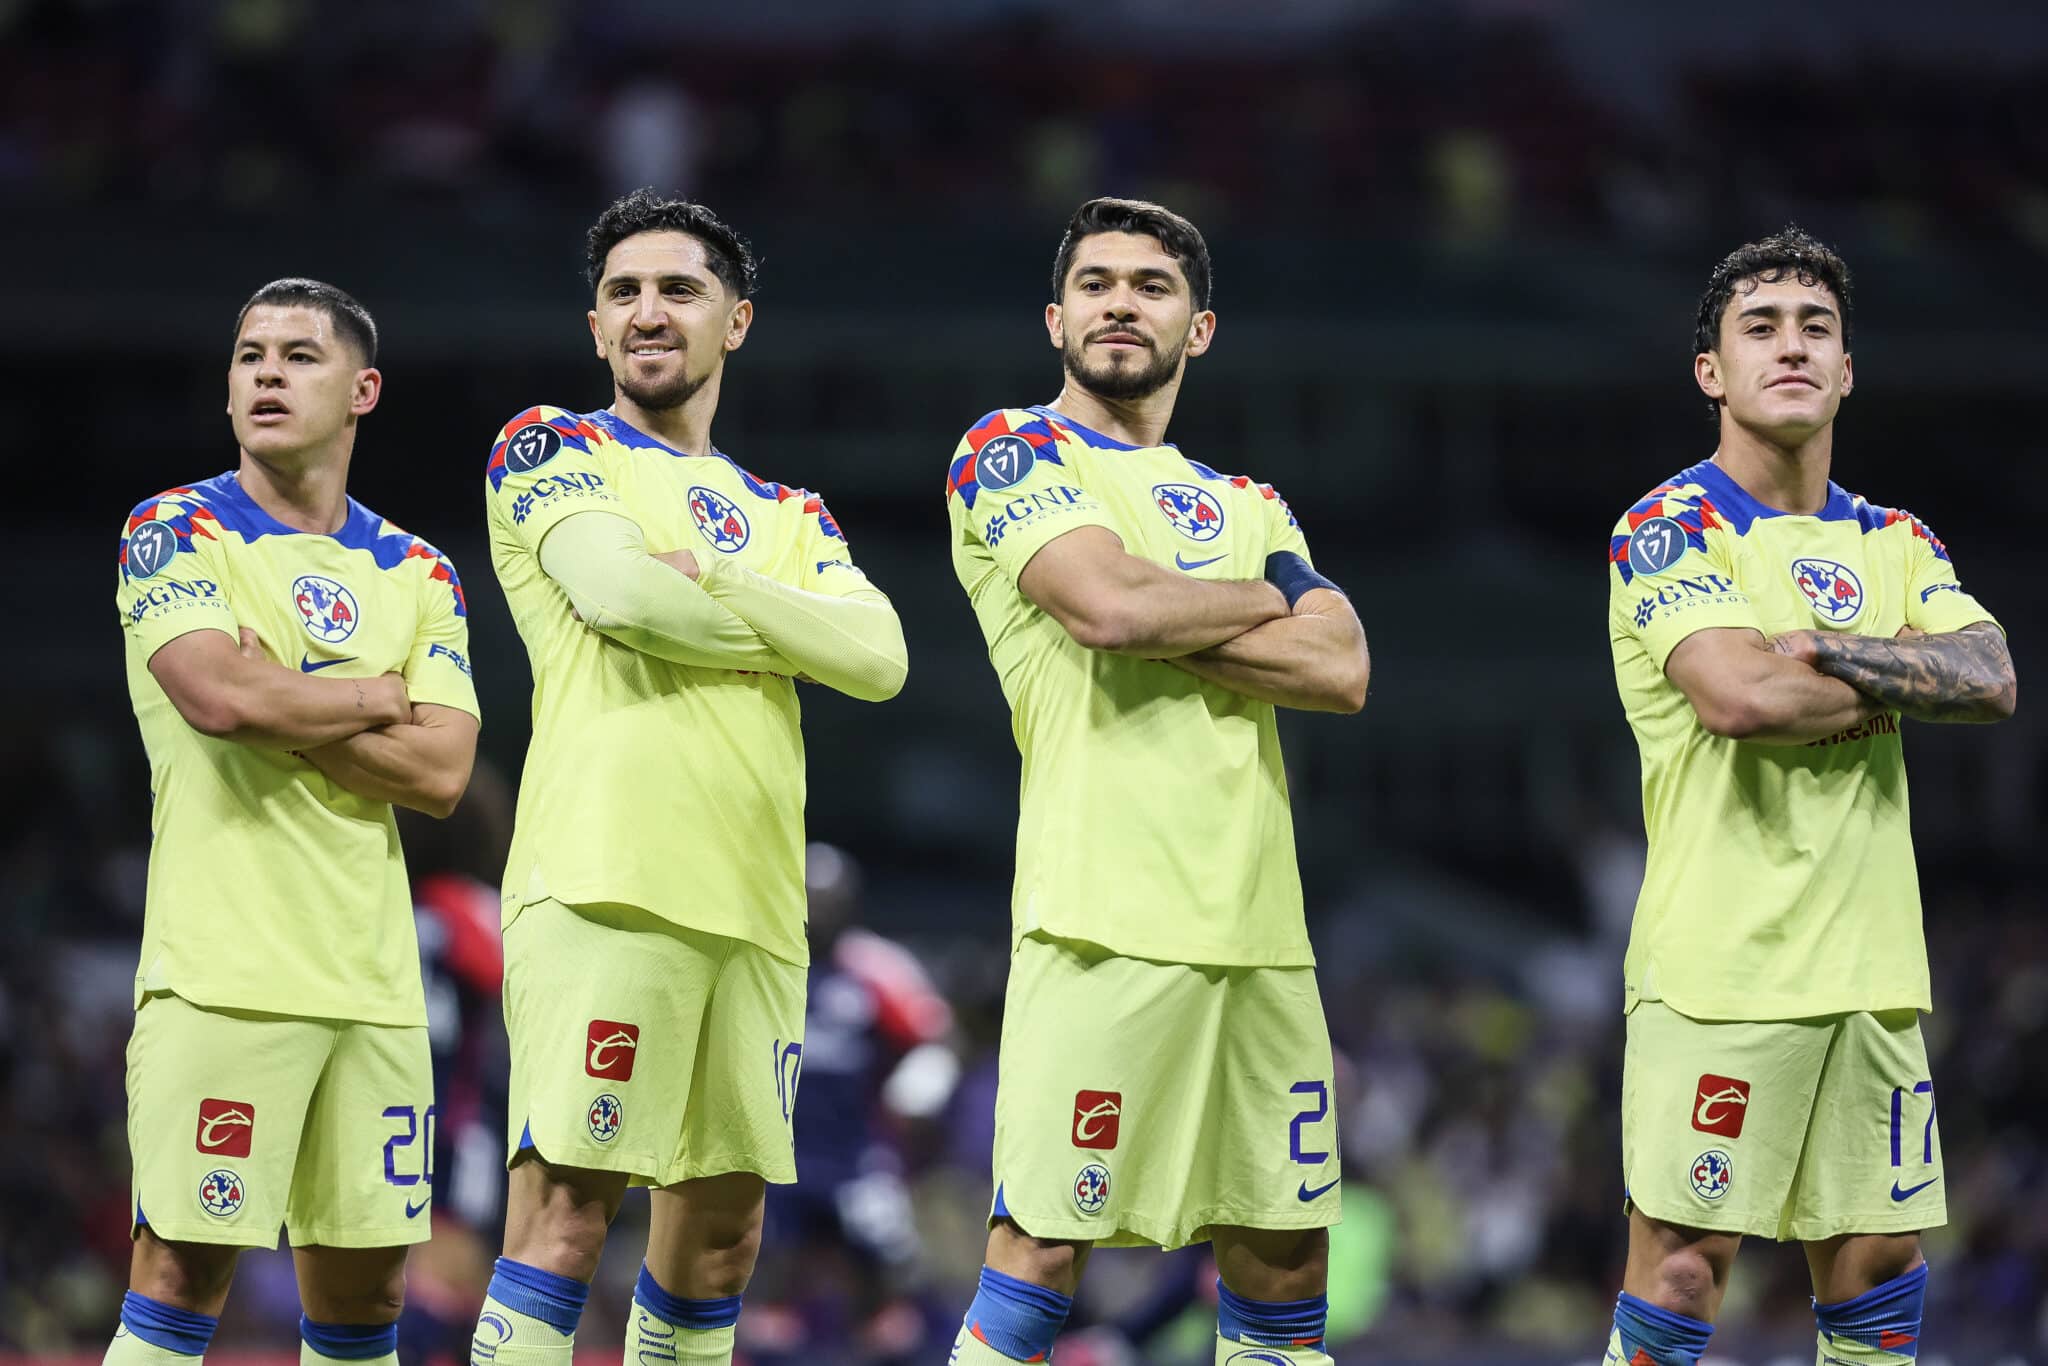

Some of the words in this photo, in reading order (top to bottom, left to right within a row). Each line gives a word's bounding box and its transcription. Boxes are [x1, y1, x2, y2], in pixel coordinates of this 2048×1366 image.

[531, 472, 604, 498] GNP
[1006, 486, 1084, 521] GNP
[146, 579, 218, 606] GNP
[1658, 574, 1733, 606] GNP
[773, 1038, 802, 1125] 10
[382, 1104, 436, 1186] 20
[1289, 1080, 1341, 1165] 2
[1890, 1080, 1936, 1167] 17
